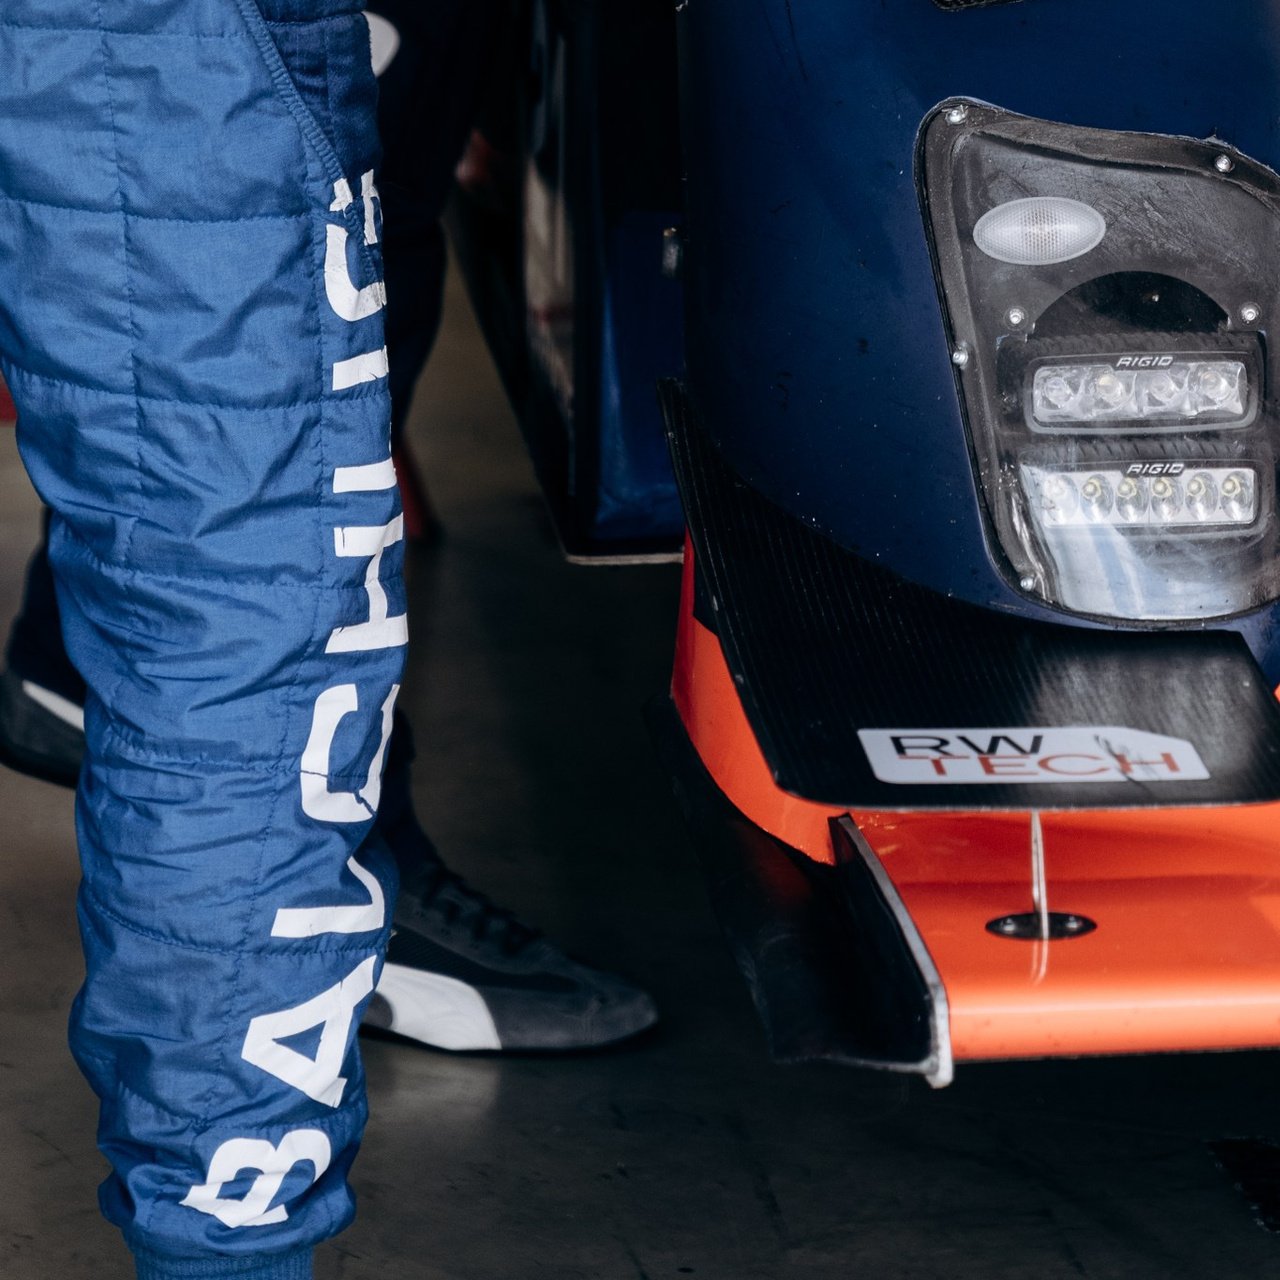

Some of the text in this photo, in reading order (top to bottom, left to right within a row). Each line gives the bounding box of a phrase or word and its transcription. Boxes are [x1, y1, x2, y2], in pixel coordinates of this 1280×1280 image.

[1116, 356, 1174, 368] RIGID
[1126, 463, 1185, 475] RIGID
[889, 735, 1044, 756] RW
[898, 752, 1181, 776] TECH
